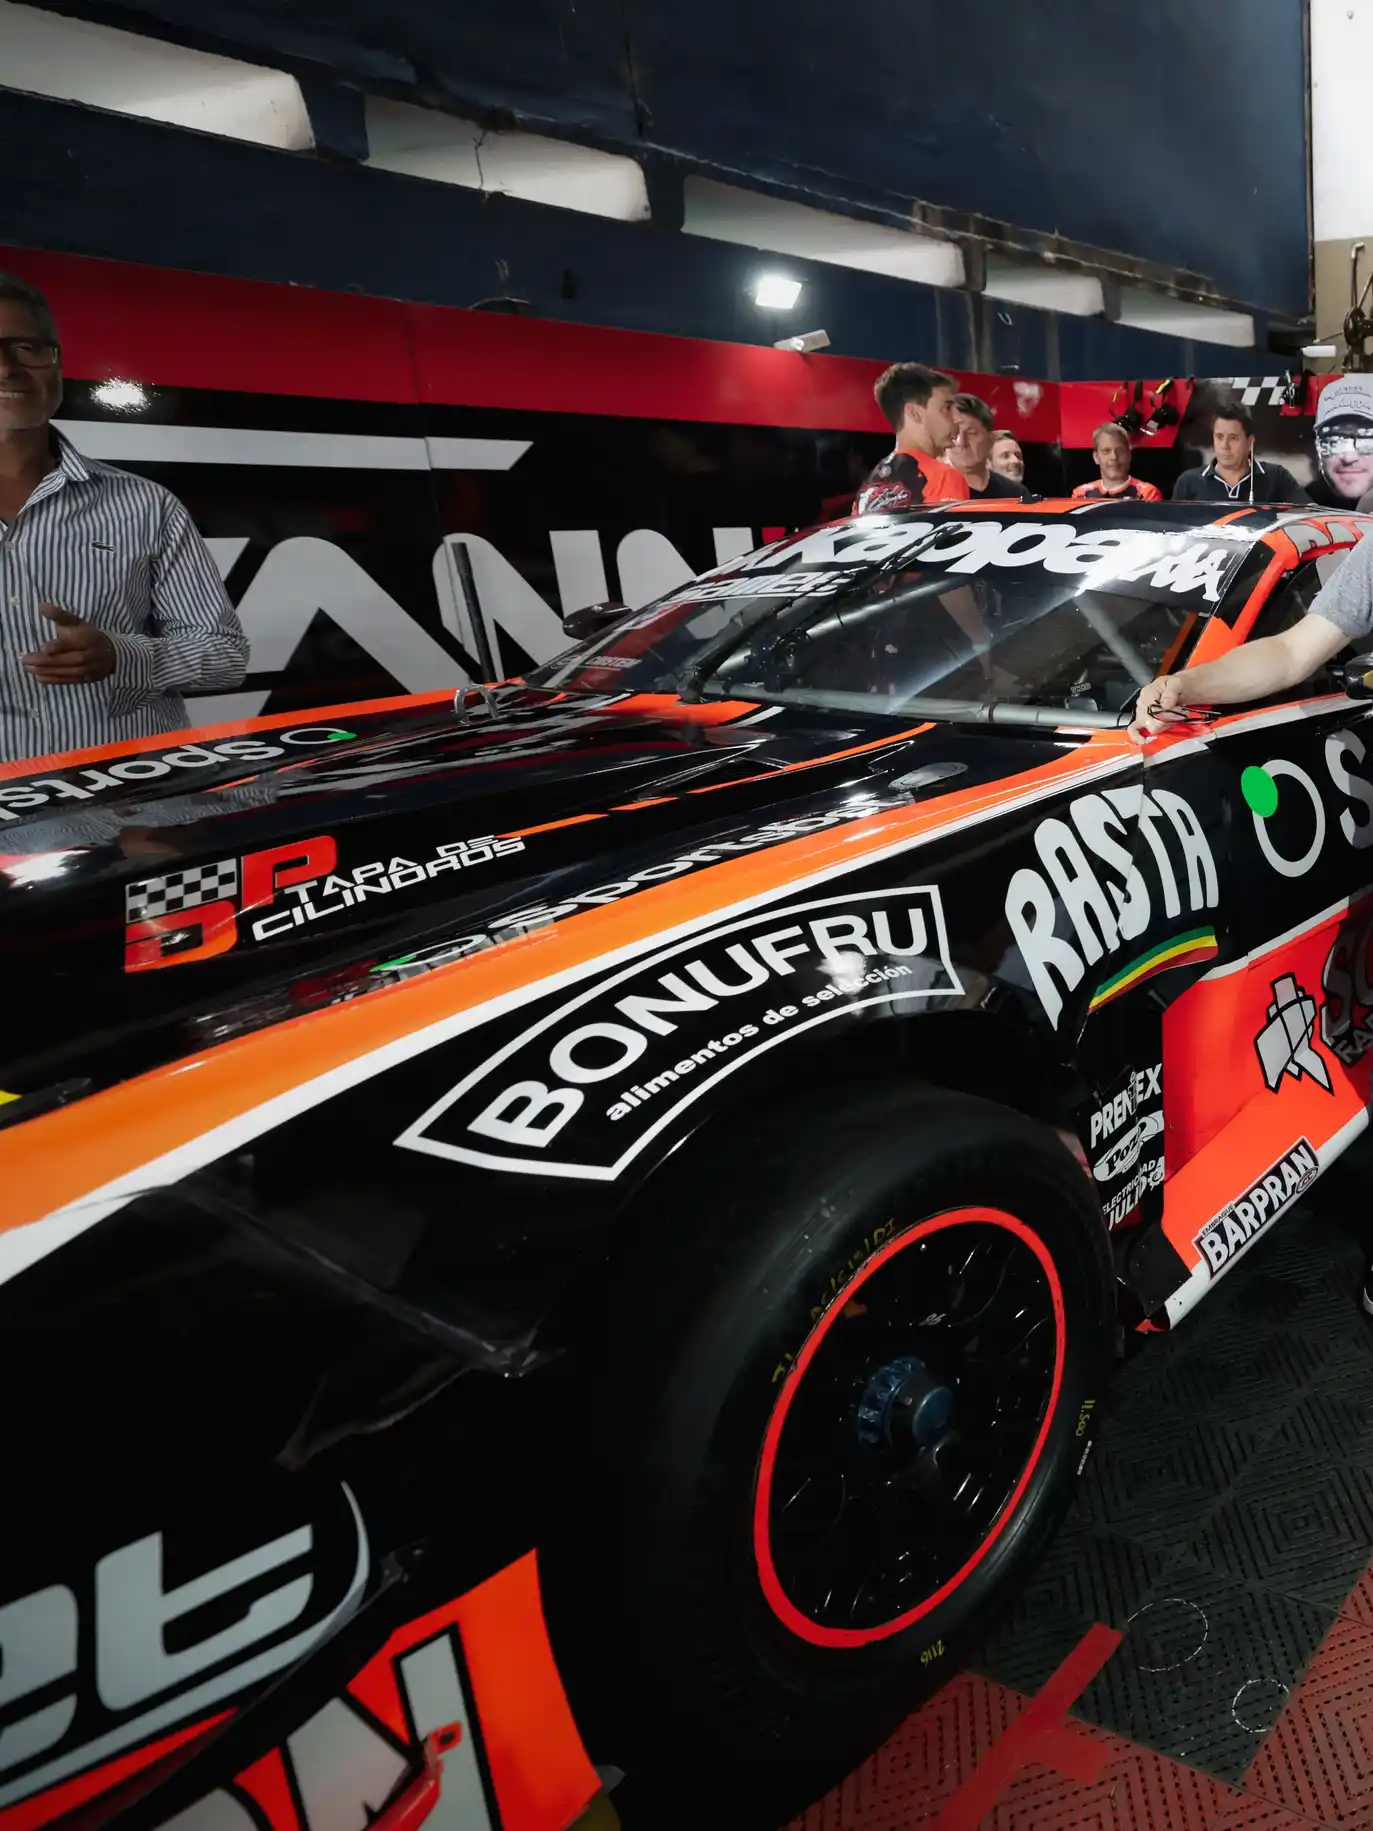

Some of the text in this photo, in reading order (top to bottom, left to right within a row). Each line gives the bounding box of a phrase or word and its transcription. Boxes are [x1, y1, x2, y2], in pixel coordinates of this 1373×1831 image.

[740, 520, 1150, 577] Kappa
[252, 836, 525, 942] CILINDROS
[284, 835, 498, 905] TAPA DE
[1005, 784, 1219, 1032] RASTA
[467, 907, 929, 1148] BONUFRU
[606, 962, 914, 1122] alimentos de selección
[1200, 1144, 1316, 1273] BARPRAN
[1202, 1203, 1235, 1236] EMBRAGUE
